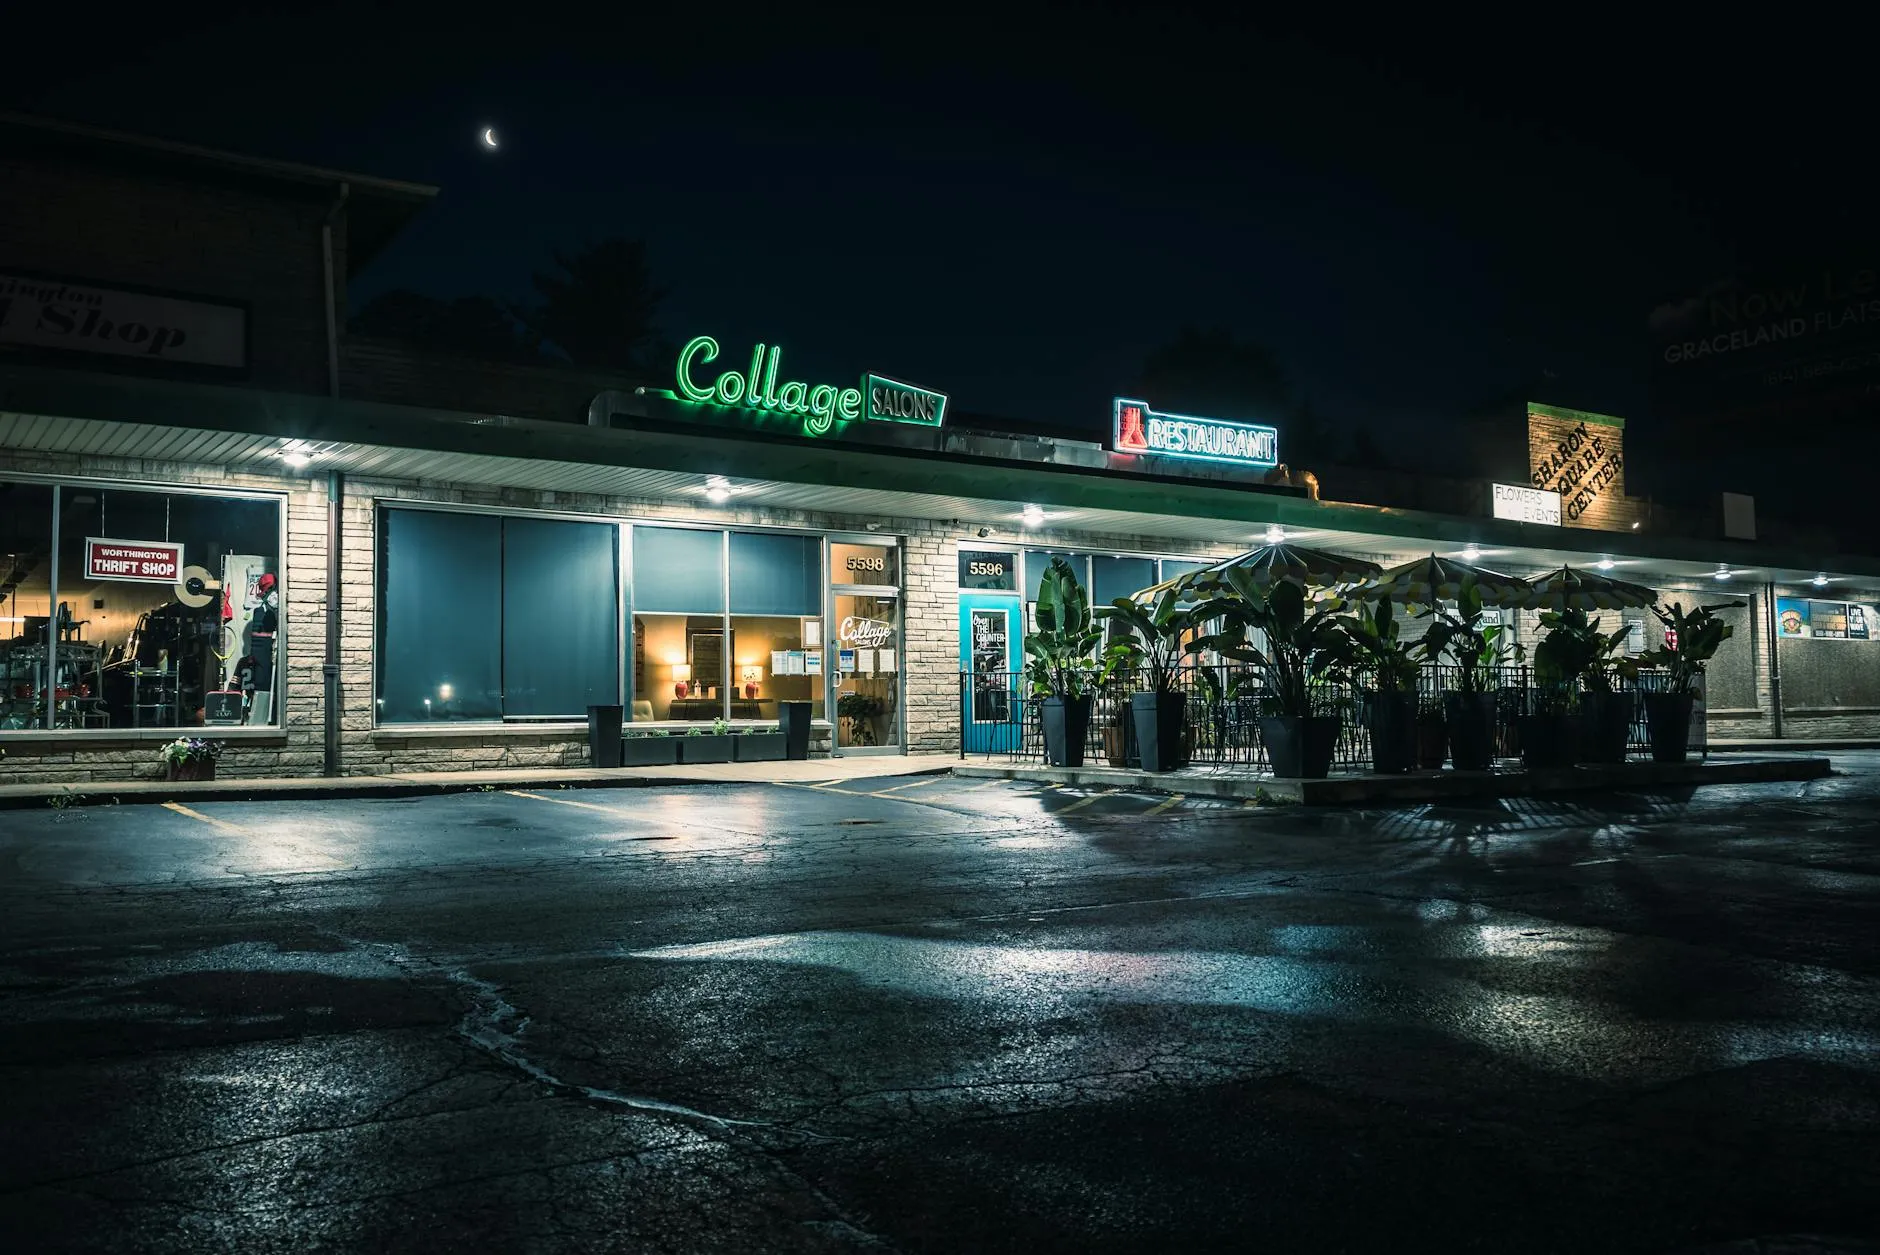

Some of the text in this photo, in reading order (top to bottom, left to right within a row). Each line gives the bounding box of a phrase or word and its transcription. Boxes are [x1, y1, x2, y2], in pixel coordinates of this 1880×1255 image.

[35, 303, 186, 355] Shop
[1664, 318, 1806, 364] GRACELAND
[676, 336, 862, 436] Collage
[872, 387, 936, 421] SALONS
[1148, 418, 1274, 460] RESTAURANT
[1532, 422, 1589, 490] SHARON
[1495, 486, 1543, 505] FLOWERS
[1567, 454, 1622, 520] CENTER
[1523, 506, 1559, 524] EVENTS
[93, 558, 175, 576] THRIFT SHOP
[101, 548, 169, 560] WORTHINGTON
[847, 556, 884, 571] 5598
[970, 561, 1003, 576] 5596
[840, 616, 891, 647] Collage
[976, 633, 1005, 642] COUNTER
